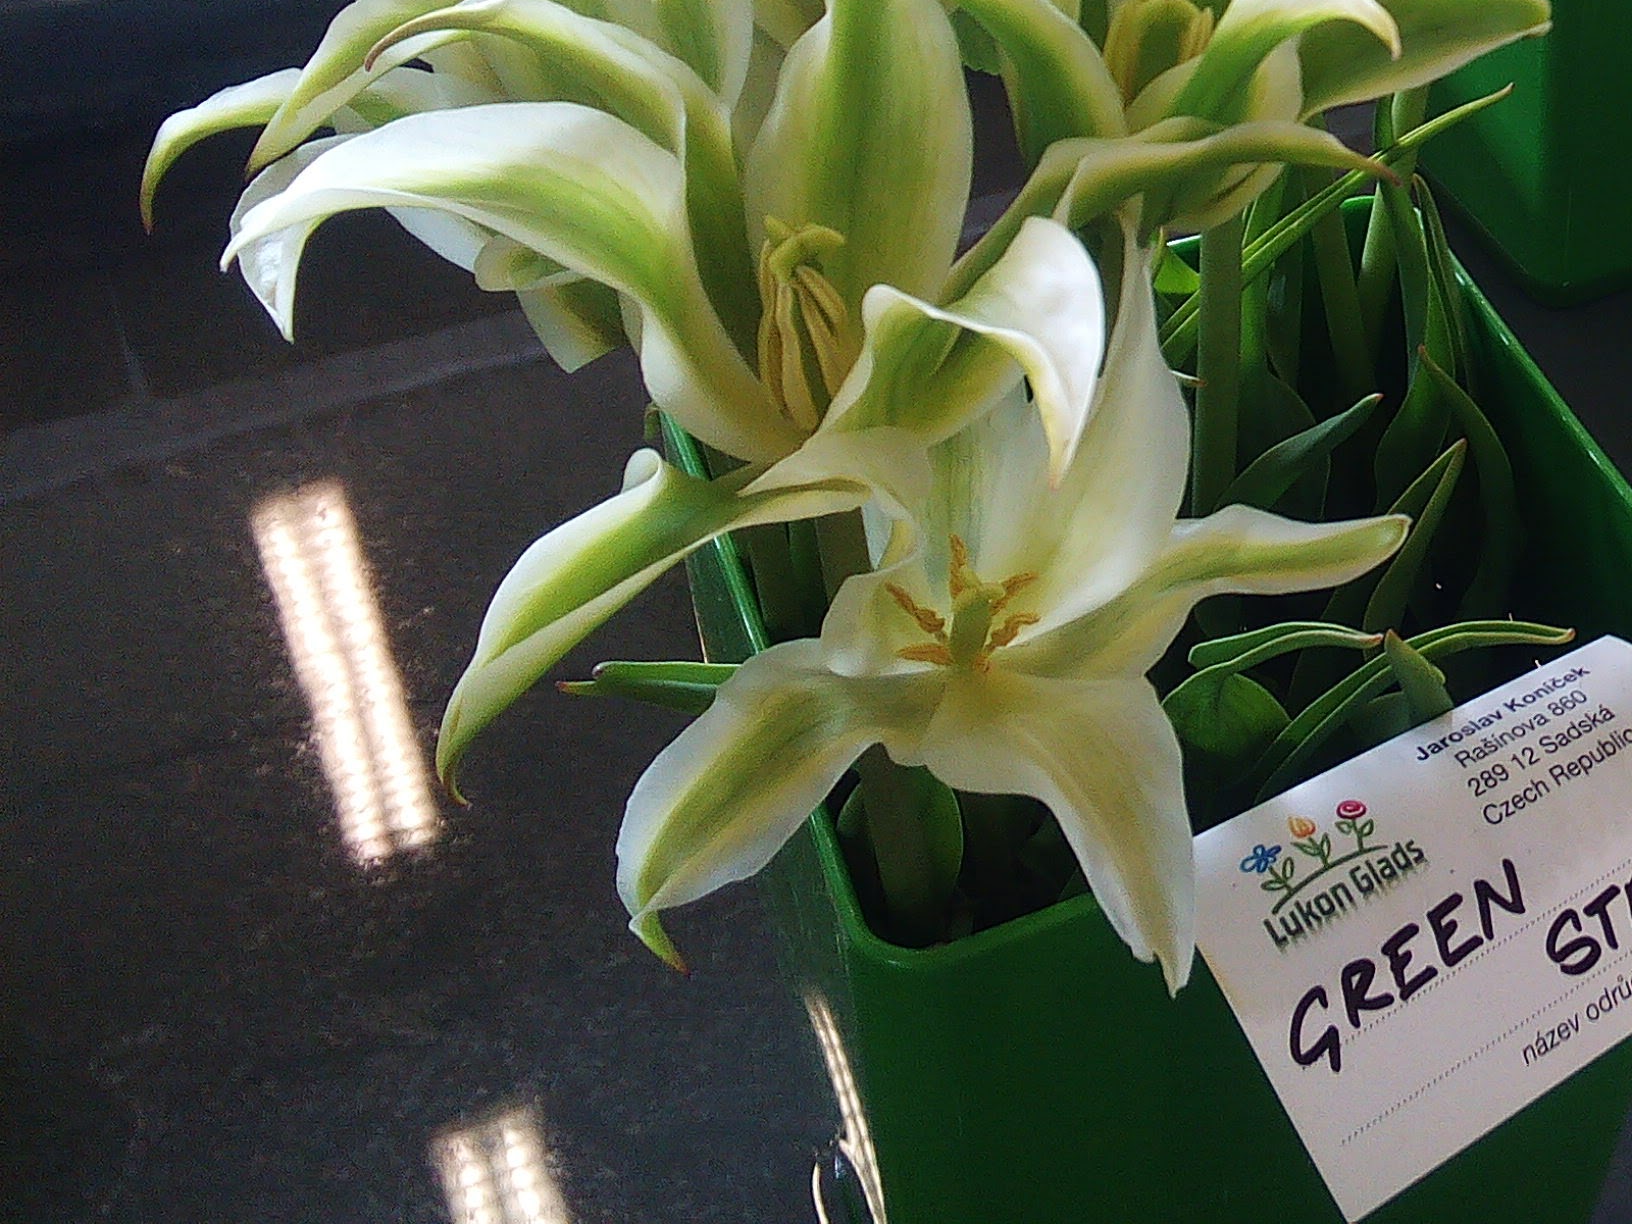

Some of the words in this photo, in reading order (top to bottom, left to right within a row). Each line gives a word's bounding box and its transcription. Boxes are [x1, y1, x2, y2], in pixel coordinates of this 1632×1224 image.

[1416, 708, 1504, 762] Jaroslav
[1454, 714, 1551, 769] Rašínova
[1547, 689, 1588, 718] 860
[1467, 762, 1511, 798] 289
[1511, 746, 1543, 772] 12
[1538, 703, 1617, 756] Sadská
[1482, 777, 1552, 826] Czech
[1263, 882, 1356, 949] Lukon
[1349, 839, 1426, 894] Glads
[1289, 858, 1527, 1073] GREEN
[1520, 1013, 1582, 1067] název
